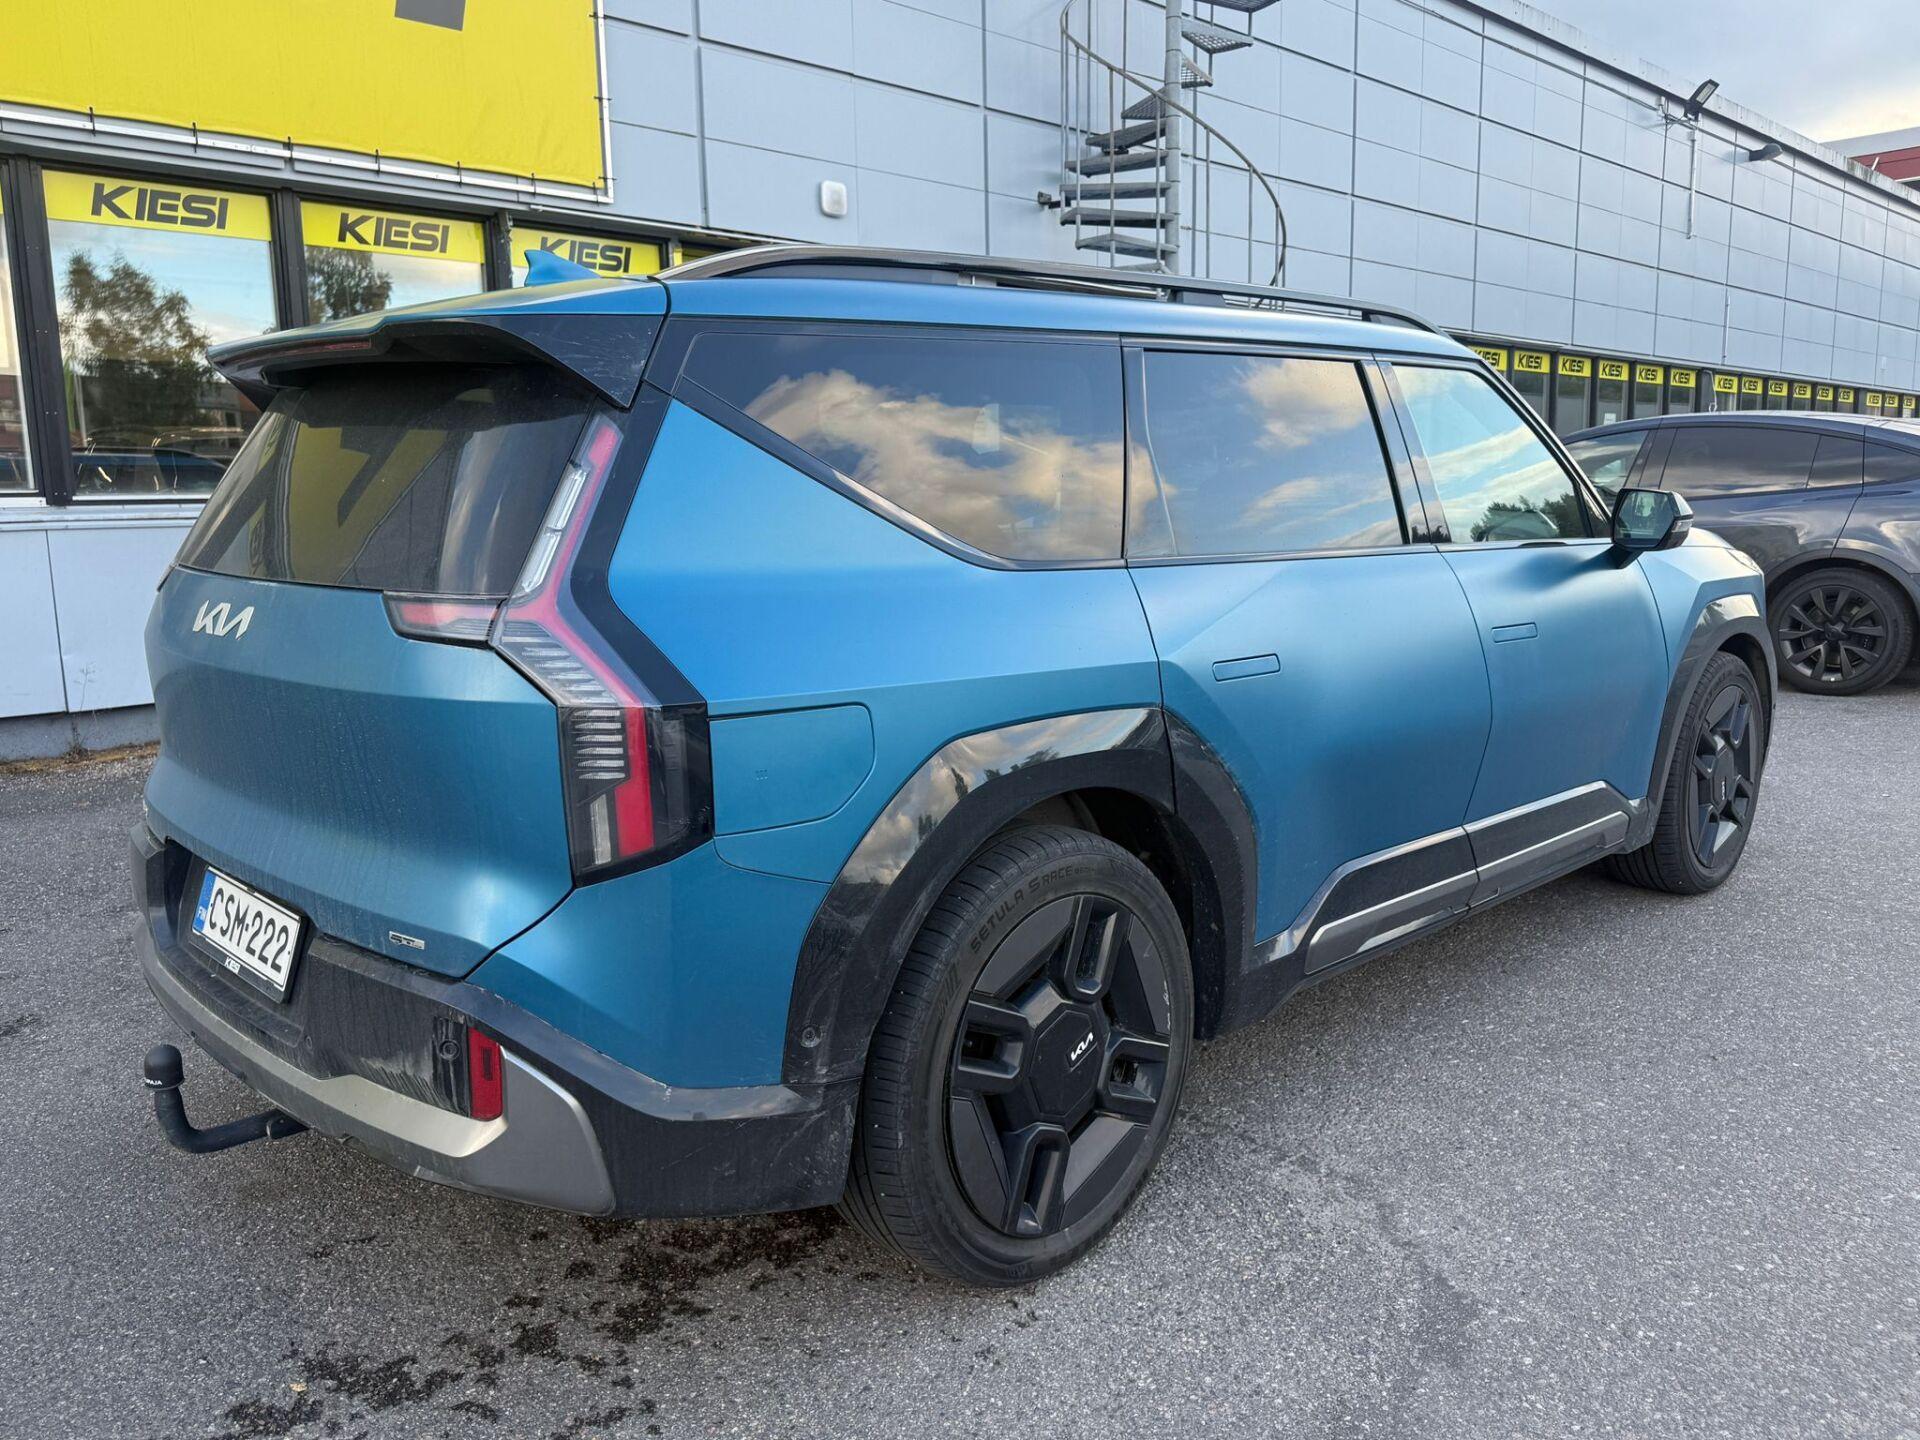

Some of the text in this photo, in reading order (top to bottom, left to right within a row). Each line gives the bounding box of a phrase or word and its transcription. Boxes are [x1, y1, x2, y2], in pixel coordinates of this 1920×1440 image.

[91, 183, 229, 230] KIESI
[338, 213, 450, 253] KIESI
[1517, 353, 1543, 370] KIESI
[1562, 358, 1584, 373] KIESI
[1601, 362, 1623, 377] KIESI
[1638, 368, 1658, 382] KIESI
[1672, 371, 1690, 385] KIESI
[1717, 377, 1733, 390] KIESI
[192, 600, 255, 640] KIA
[209, 888, 289, 974] CSM-222
[970, 889, 1025, 953] SETULA
[1071, 1032, 1093, 1061] KIA
